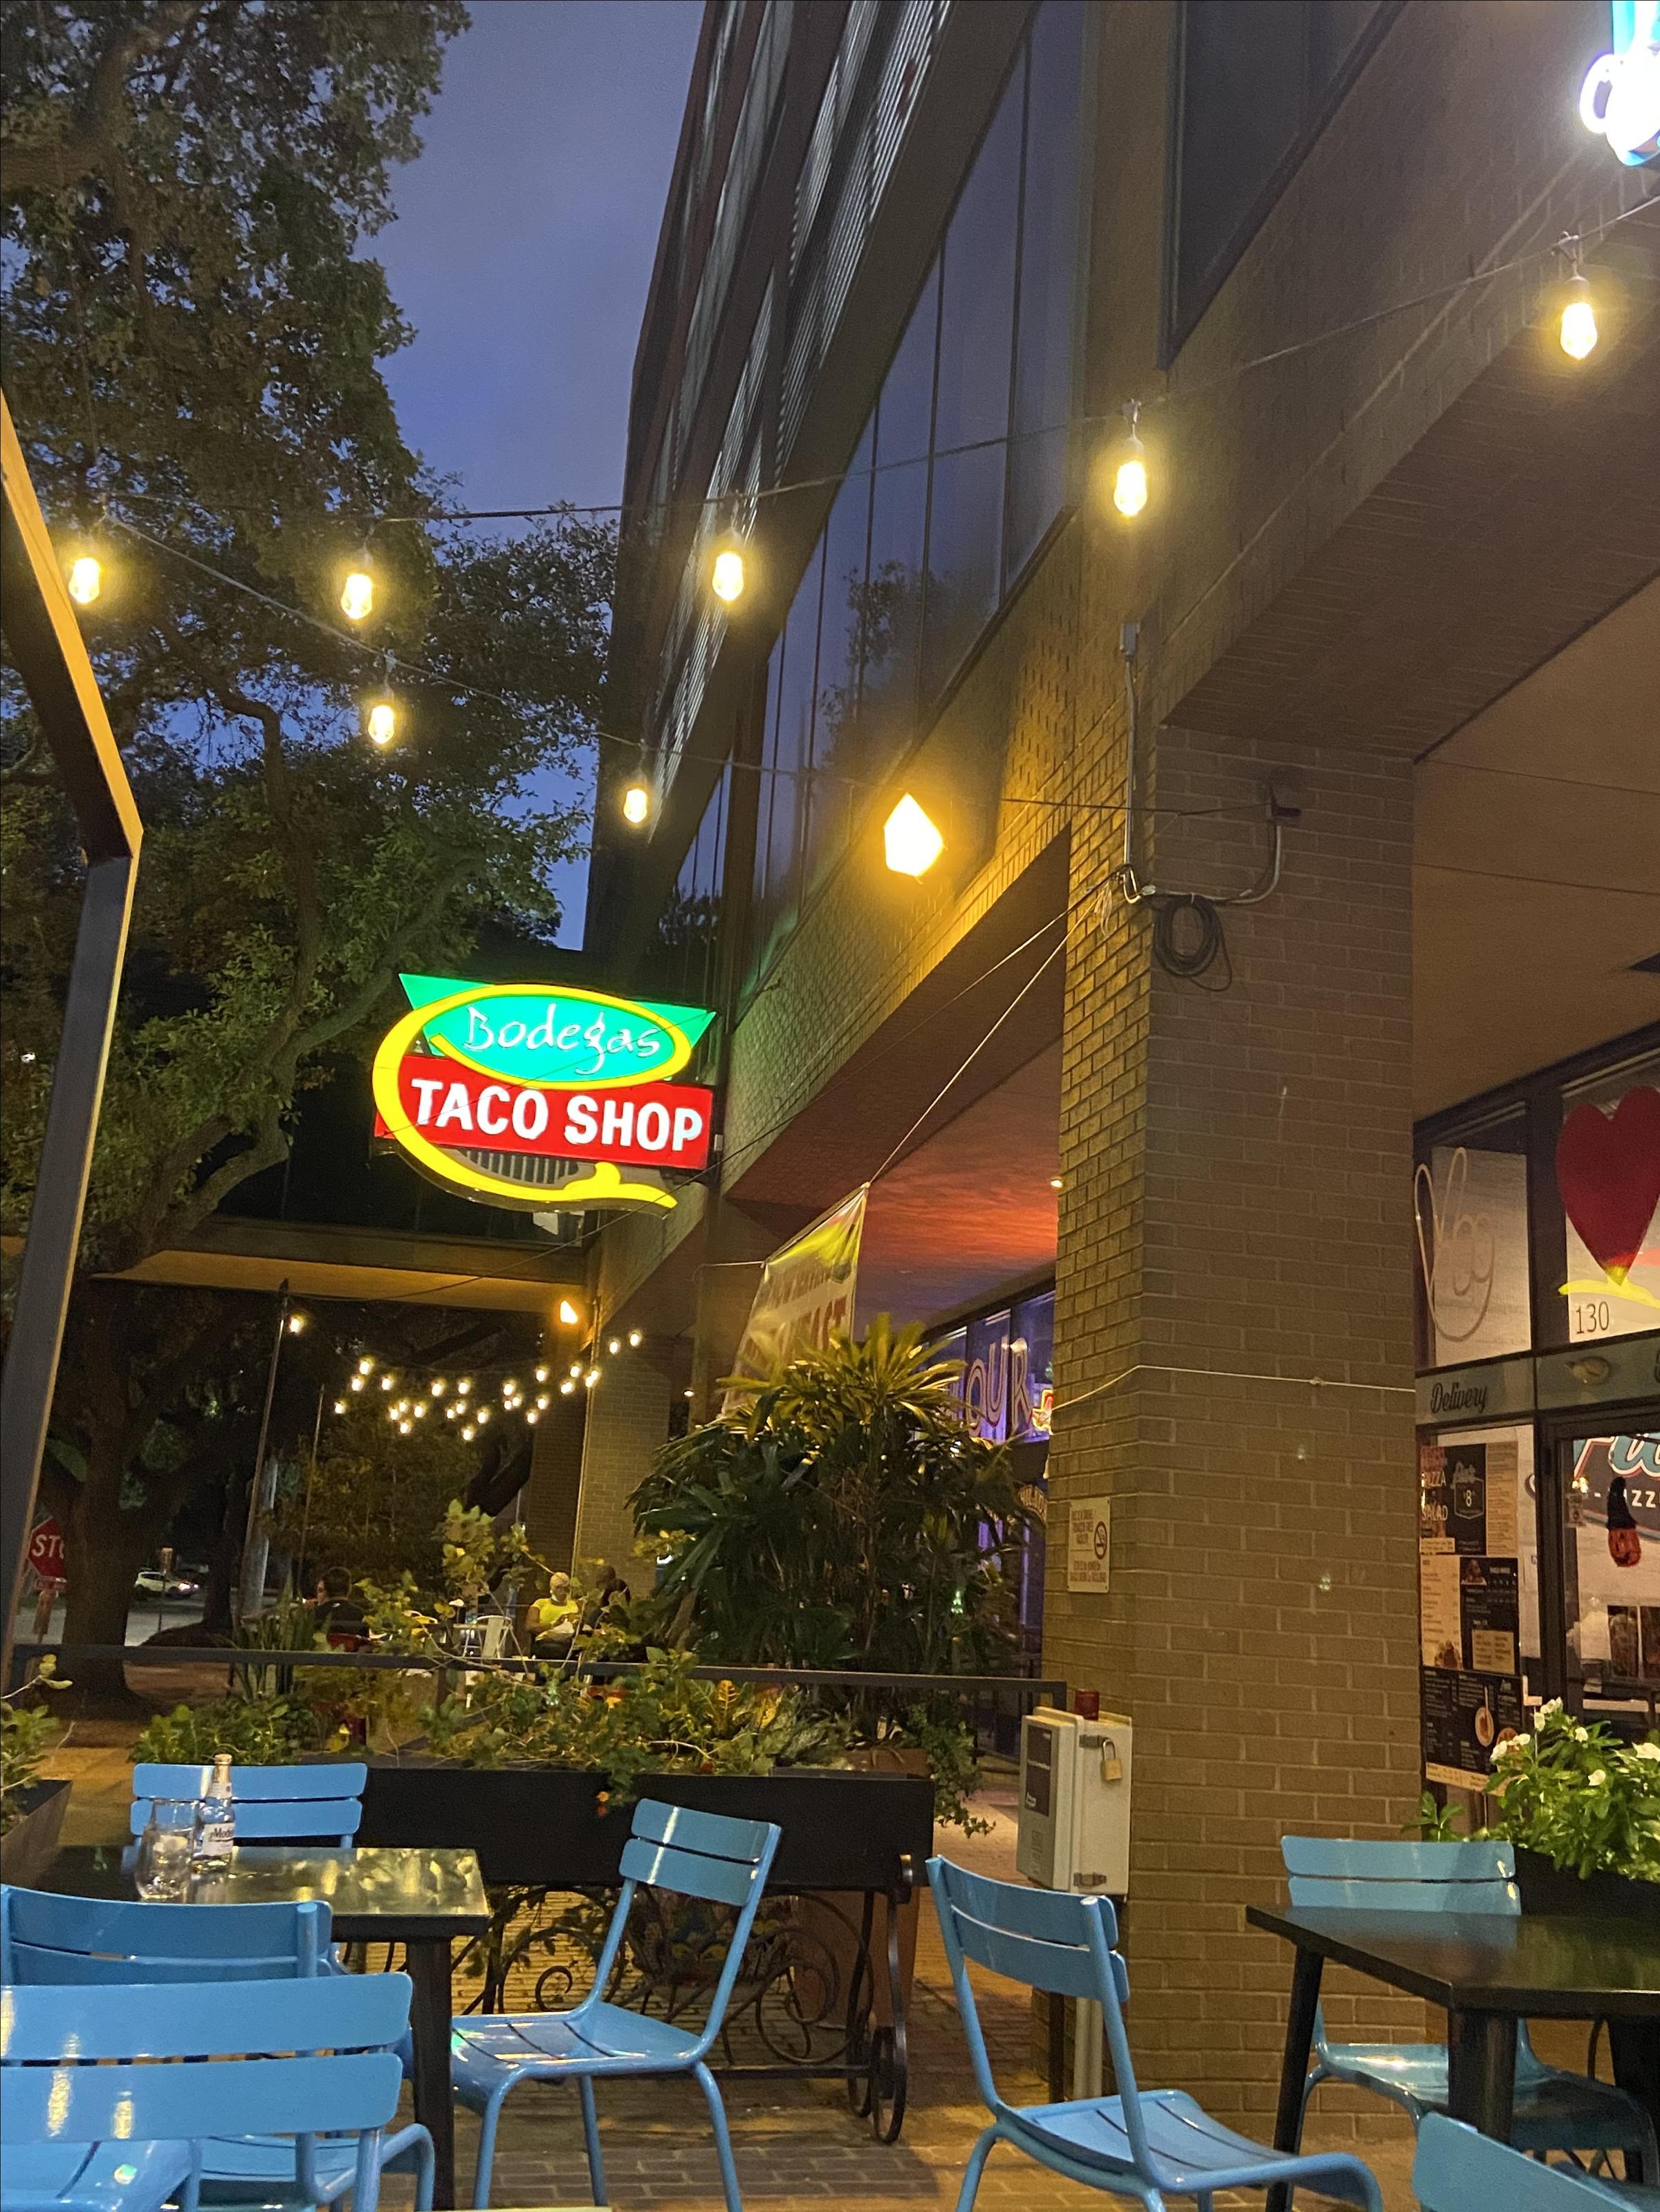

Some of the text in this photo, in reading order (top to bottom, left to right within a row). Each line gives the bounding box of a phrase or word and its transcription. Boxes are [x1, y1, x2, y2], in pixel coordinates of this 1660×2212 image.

[464, 1003, 661, 1075] Bodegas
[411, 1078, 703, 1152] TACO SHOP
[1575, 1300, 1610, 1335] 130
[1430, 1382, 1488, 1414] Delivery
[1421, 1505, 1448, 1521] SALAD
[32, 1534, 64, 1559] ST
